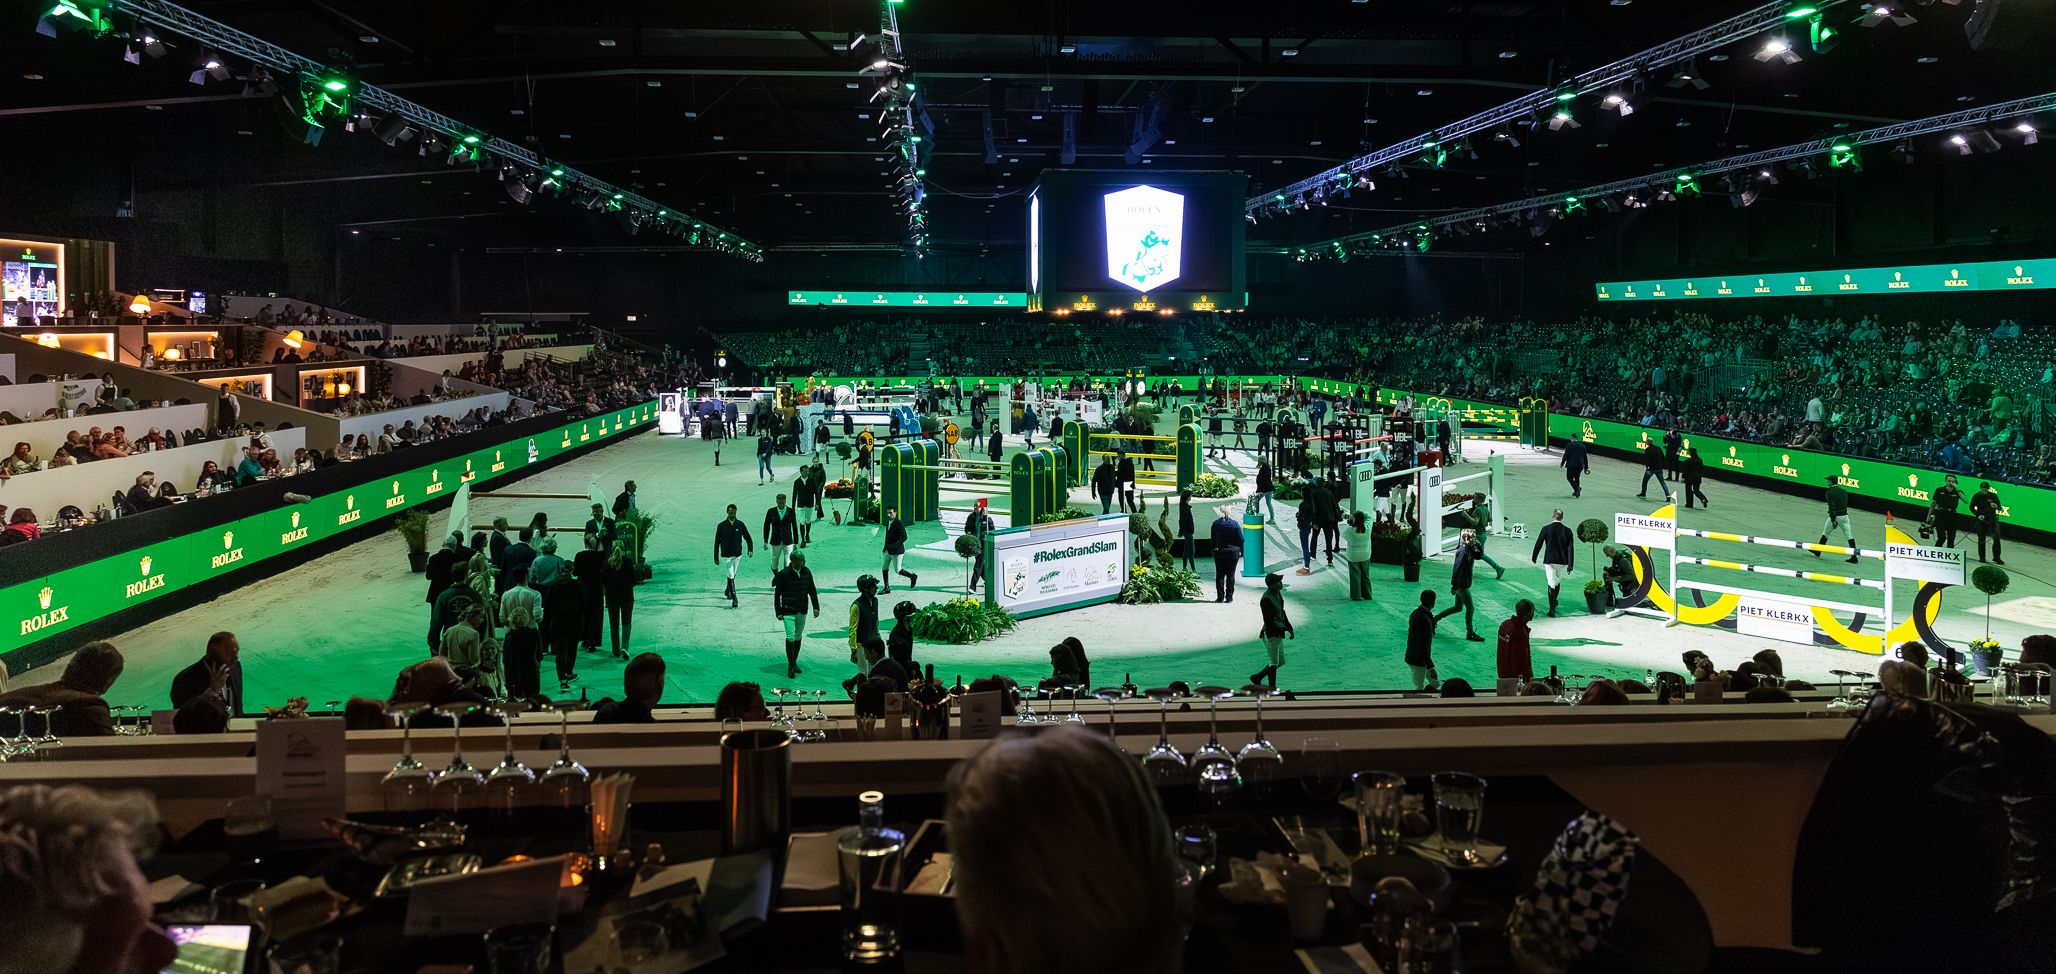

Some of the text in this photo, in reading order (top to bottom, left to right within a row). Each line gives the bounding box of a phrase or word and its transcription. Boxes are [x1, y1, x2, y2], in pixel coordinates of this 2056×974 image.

[1888, 281, 1910, 289] ROLEX
[1944, 279, 1969, 287] ROLEX
[2007, 276, 2034, 285] ROLEX
[1283, 438, 1302, 449] VBL
[1394, 432, 1413, 442] VBL
[1334, 442, 1353, 452] VBL
[1722, 456, 1744, 468] ROLEX
[1773, 465, 1798, 478] ROLEX
[426, 482, 443, 495] ROLEX
[1838, 476, 1859, 488] OLEX
[1897, 486, 1929, 501] ROLEX
[386, 494, 405, 508] ROLEX
[338, 509, 361, 525] ROLEX
[1618, 516, 1672, 529] PIET KLERKX
[1513, 525, 1522, 533] 12
[281, 527, 308, 545] ROLEX
[211, 547, 244, 569] ROLEX
[1033, 540, 1118, 564] #RolexGrandSlam
[1889, 546, 1960, 562] PIET KLERKX
[125, 573, 166, 599] ROLEX
[1740, 605, 1809, 623] PIET KLERKX
[20, 606, 69, 636] ROLEX
